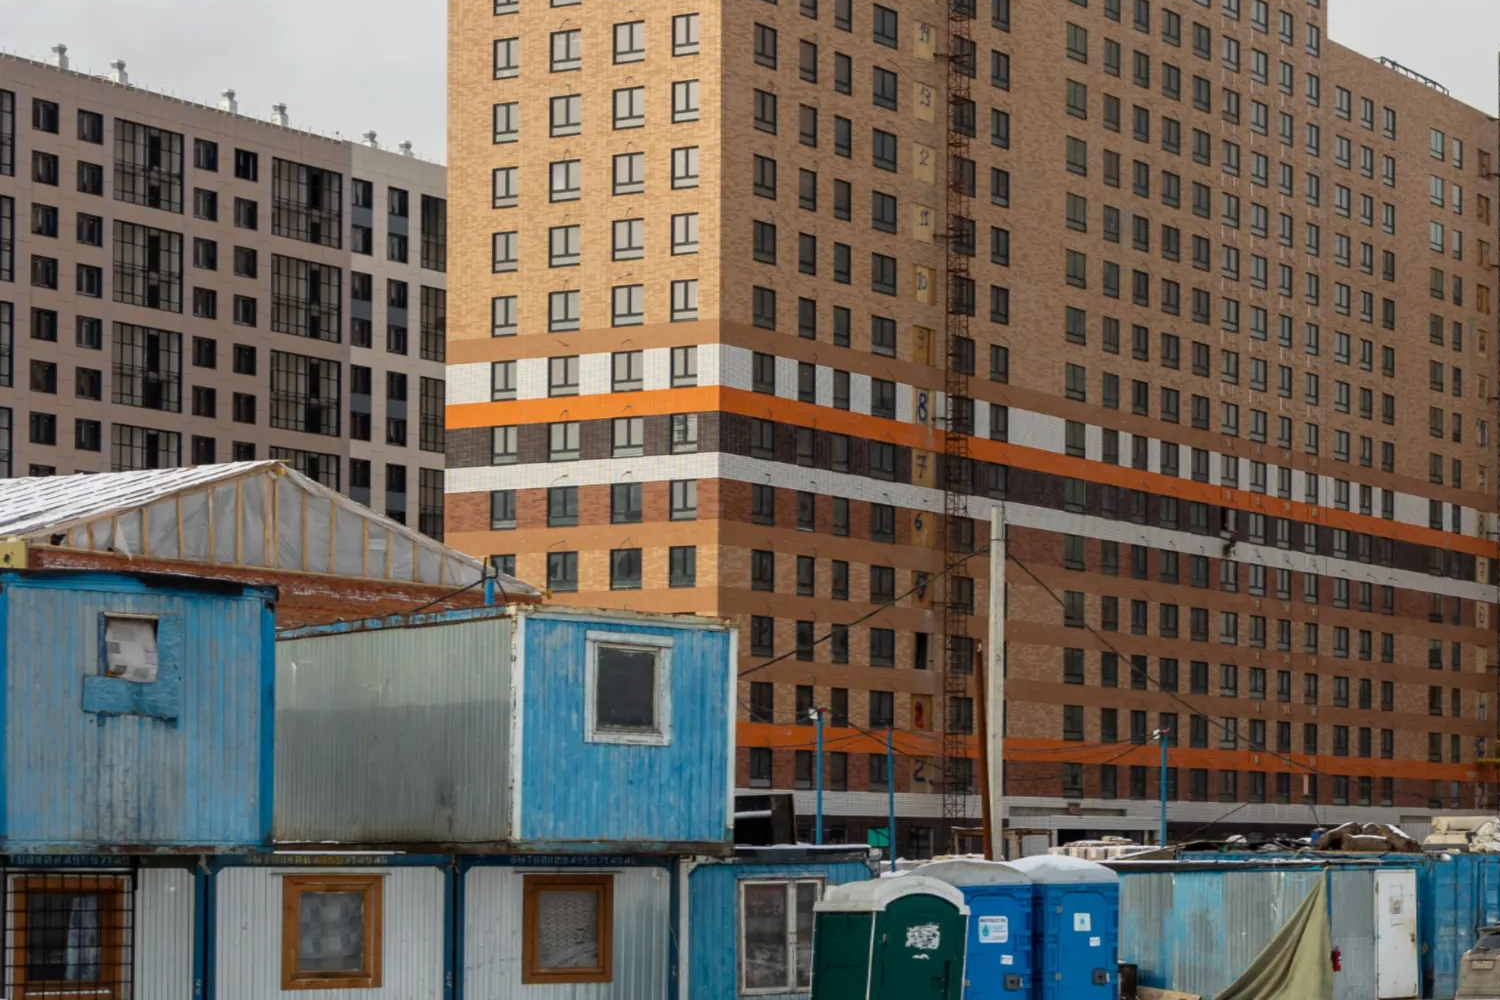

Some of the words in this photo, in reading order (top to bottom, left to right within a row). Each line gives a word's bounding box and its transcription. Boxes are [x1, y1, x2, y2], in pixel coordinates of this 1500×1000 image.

[917, 391, 928, 423] 8
[915, 454, 928, 479] 7
[914, 511, 923, 532] 6
[914, 758, 925, 783] 2
